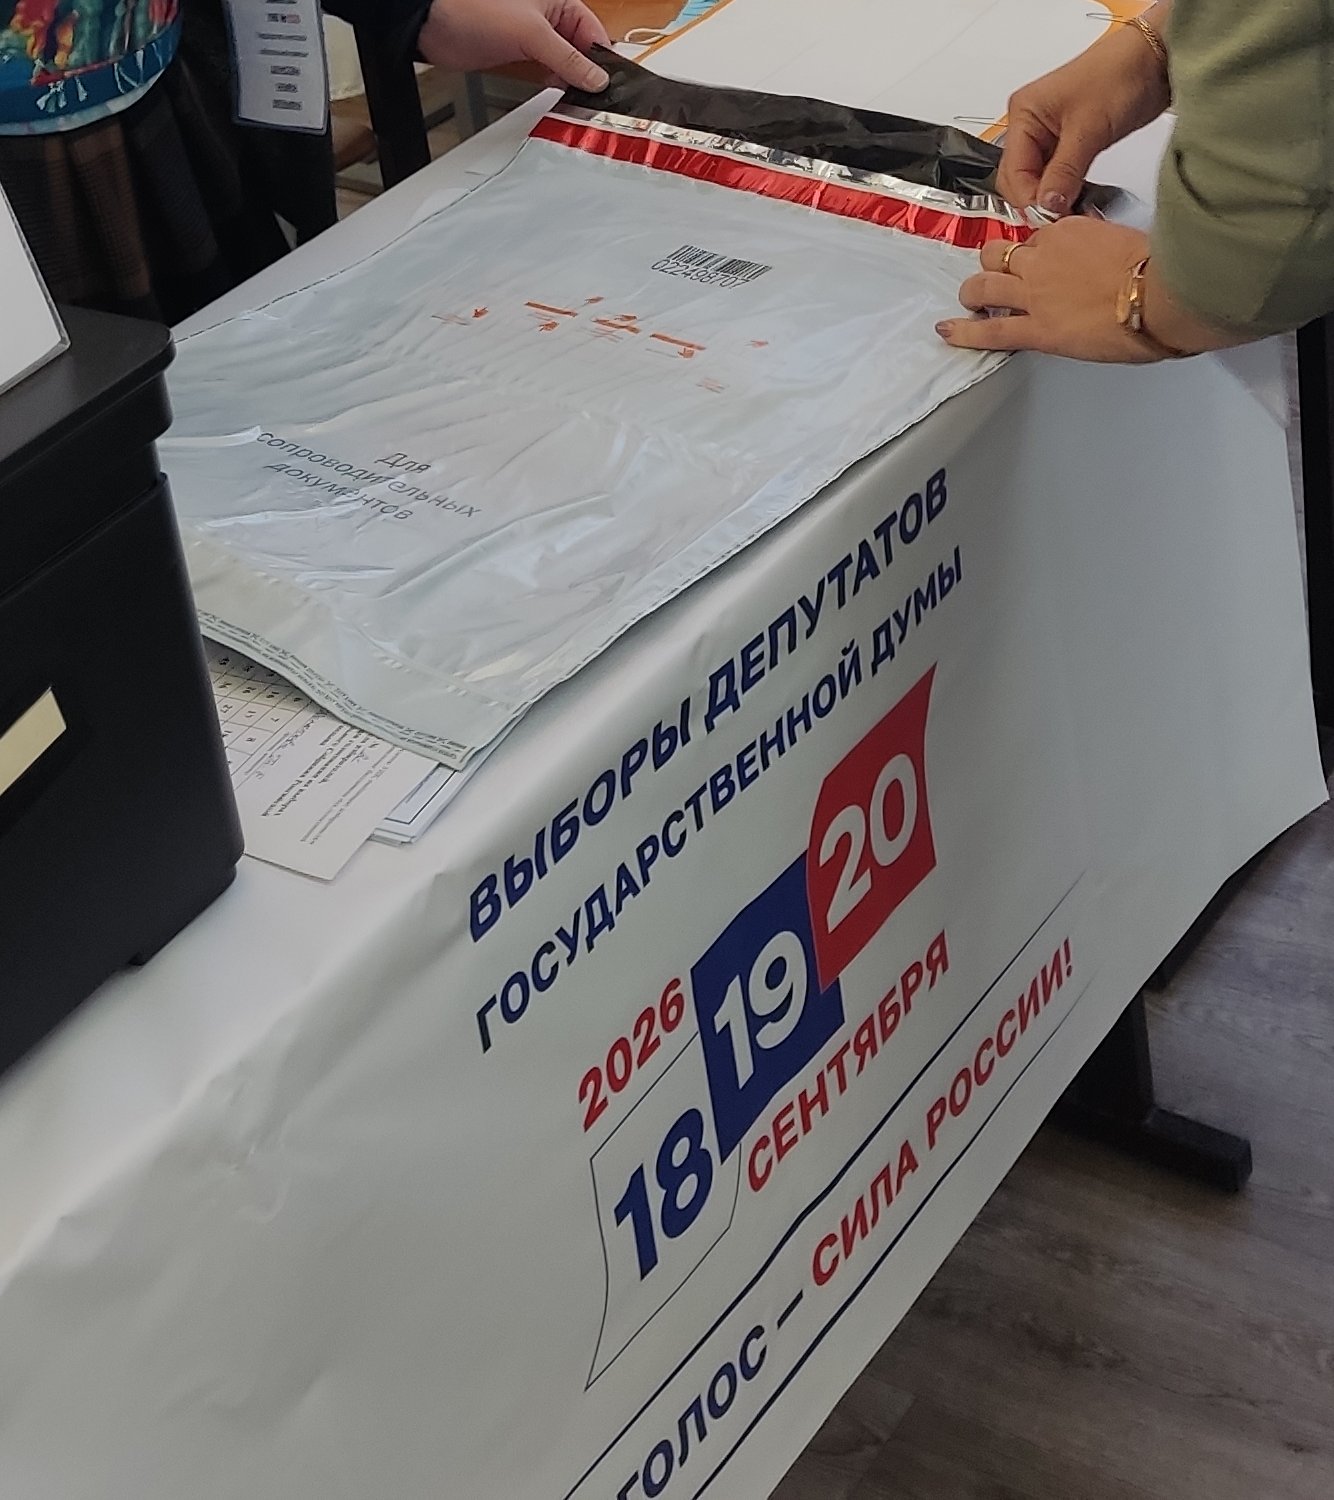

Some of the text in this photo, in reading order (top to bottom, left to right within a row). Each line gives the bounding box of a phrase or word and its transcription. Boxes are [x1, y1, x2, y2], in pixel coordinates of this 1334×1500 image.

[256, 432, 482, 518] сопроводительных
[263, 462, 414, 520] документов
[374, 452, 431, 474] Для
[467, 468, 948, 943] ВЫБОРЫ ДЕПУТАТОВ
[476, 546, 962, 1052] ГОСУДАРСТВЕННОЙ ДУМЫ
[578, 977, 685, 1132] 2026
[613, 753, 919, 1282] 18 19 20
[747, 928, 950, 1192] СЕНТЯБРЯ
[812, 1139, 919, 1287] СИЛА
[926, 937, 1074, 1150] РОССИИ!
